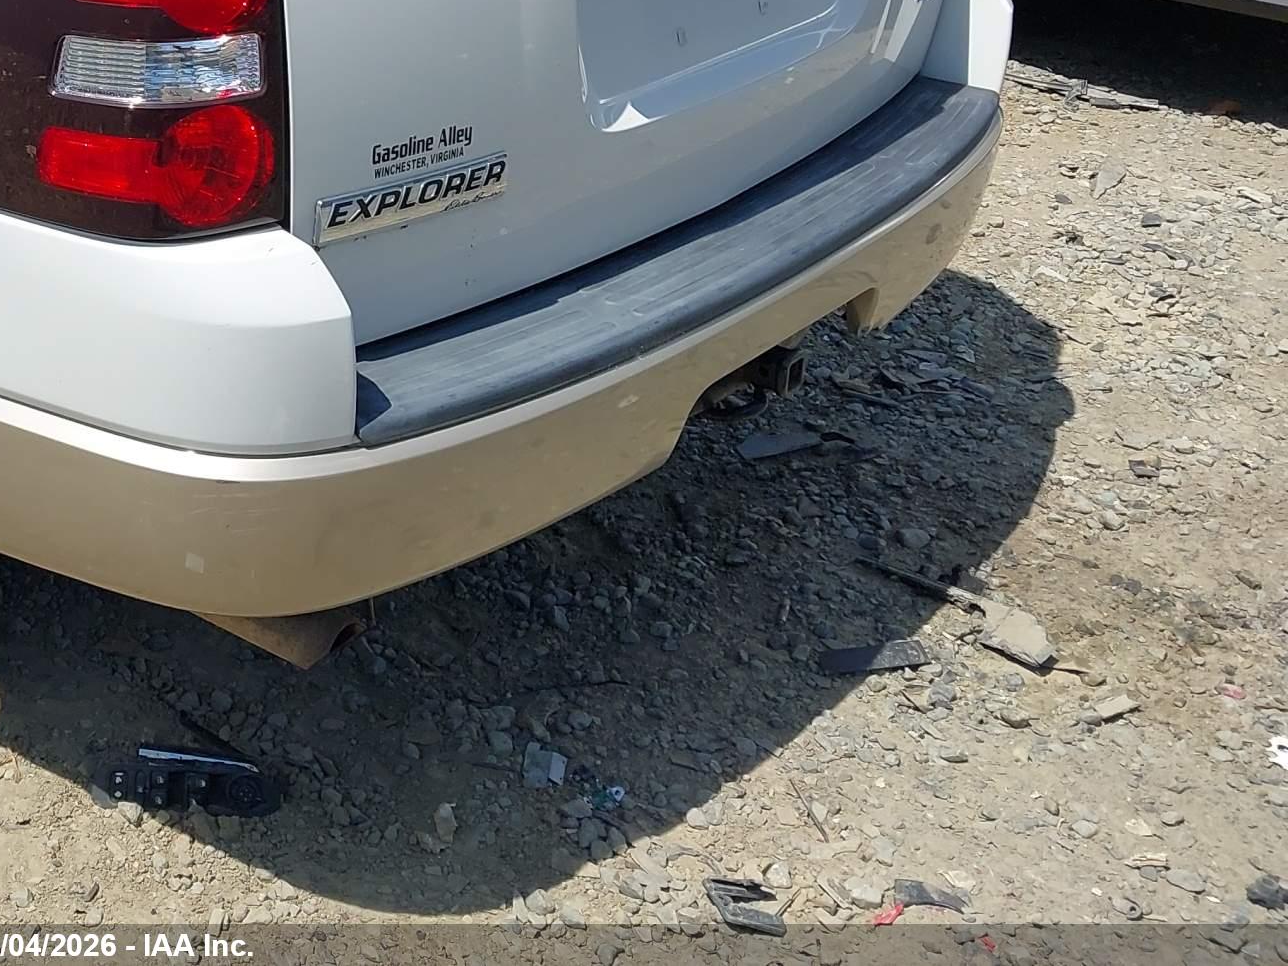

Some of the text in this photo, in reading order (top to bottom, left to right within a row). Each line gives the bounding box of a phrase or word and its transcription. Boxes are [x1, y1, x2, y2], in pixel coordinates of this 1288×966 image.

[372, 125, 473, 165] Gasoline Alley
[374, 146, 465, 179] WINCHESTER, VIRGINIA
[326, 160, 506, 228] EXPLORER
